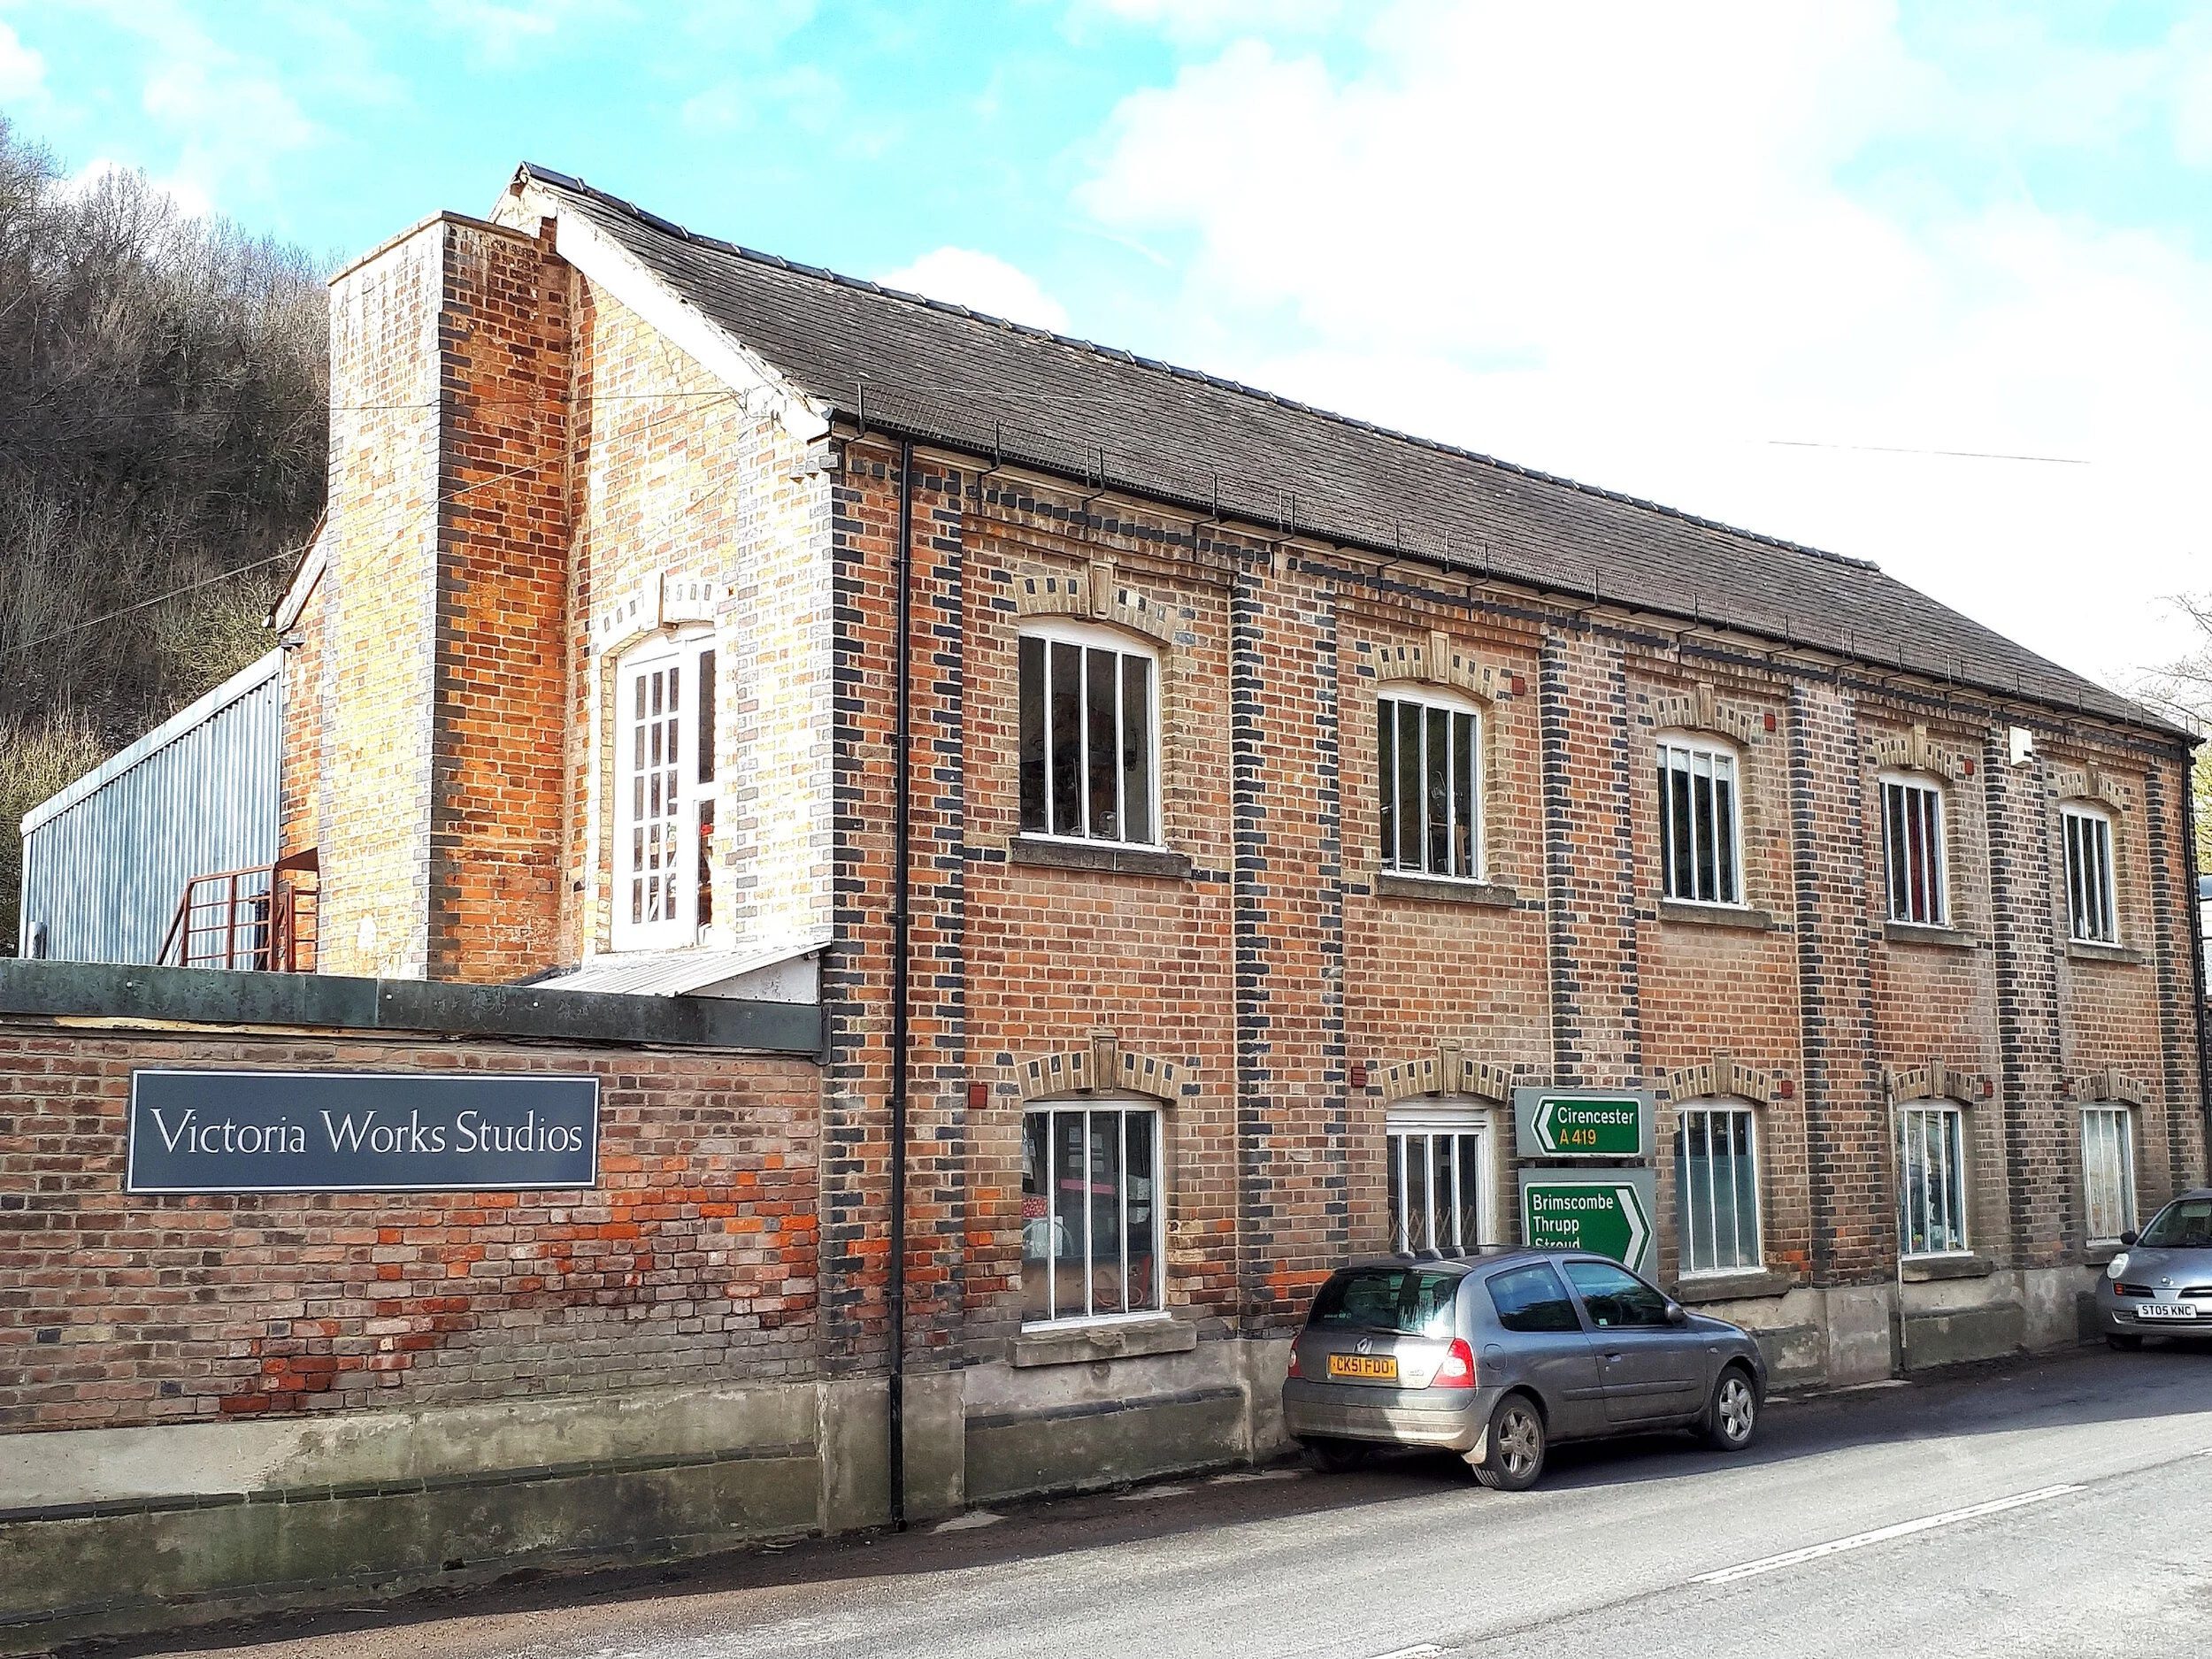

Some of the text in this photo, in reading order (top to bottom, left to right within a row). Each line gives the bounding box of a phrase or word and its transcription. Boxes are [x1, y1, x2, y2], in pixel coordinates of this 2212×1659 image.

[1557, 1106, 1634, 1125] Cirencester
[150, 1107, 584, 1154] Victoria Works Studios
[1532, 1193, 1614, 1211] Brimscombe
[1532, 1215, 1579, 1235] Thrupp
[2170, 1305, 2192, 1317] KNC
